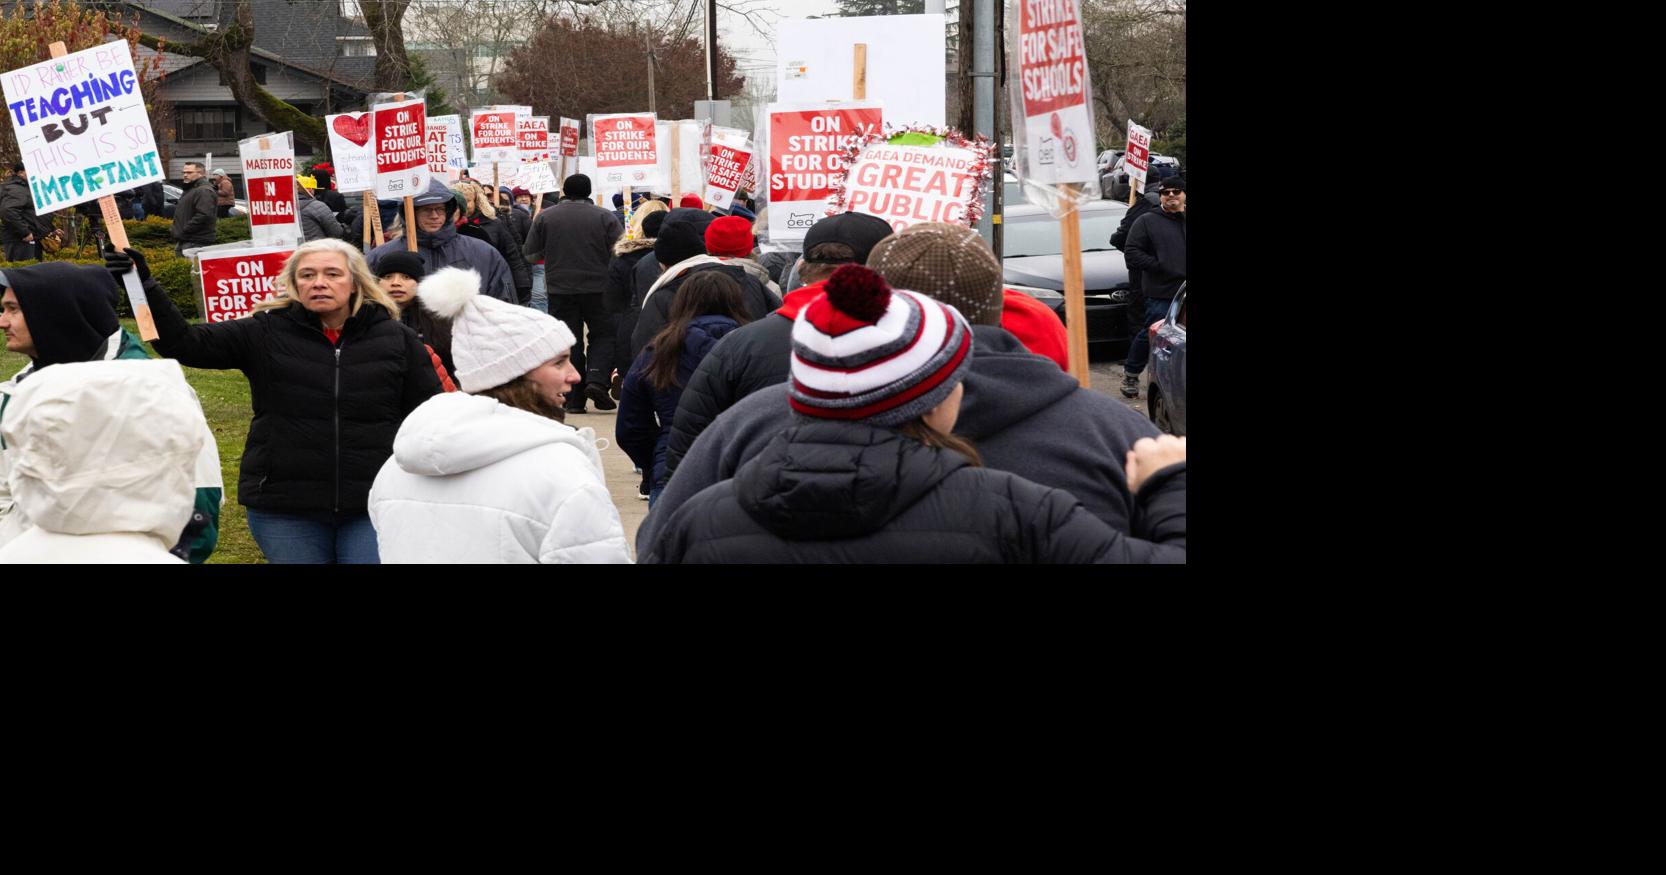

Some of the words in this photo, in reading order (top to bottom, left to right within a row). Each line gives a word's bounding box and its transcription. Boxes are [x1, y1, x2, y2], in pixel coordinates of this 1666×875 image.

[1028, 0, 1074, 28] STRIKE
[1021, 31, 1048, 65] FOR
[1049, 25, 1082, 61] SAFE
[95, 48, 123, 70] BE
[1024, 62, 1082, 100] SCHOOLS
[9, 69, 136, 126] TEACHING
[41, 106, 113, 143] BUT
[396, 110, 410, 123] ON
[616, 120, 633, 130] ON
[811, 115, 840, 132] ON
[385, 122, 418, 138] STRIKE
[480, 122, 509, 130] STRIKE
[381, 138, 405, 152] FOR
[406, 135, 421, 147] OUR
[474, 136, 515, 144] STUDENTS
[604, 130, 645, 141] STRIKE
[788, 135, 853, 152] STRIK
[1130, 130, 1148, 147] GAEA
[27, 142, 78, 174] THIS
[92, 132, 116, 159] IS
[123, 124, 149, 147] SO
[601, 141, 624, 151] FOR
[626, 140, 650, 150] OUR
[1133, 146, 1142, 158] ON
[377, 147, 426, 165] STUDENTS
[597, 150, 656, 161] STUDENTS
[710, 154, 740, 171] STRIKE
[720, 149, 735, 160] ON
[781, 154, 822, 171] FOR
[865, 150, 899, 161] GAEA
[1127, 151, 1148, 169] STRIKE
[246, 158, 293, 170] MAESTROS
[717, 166, 742, 181] SAFE
[771, 173, 843, 190] STUDE
[857, 162, 969, 198] GREAT
[251, 201, 294, 216] HUELGA
[847, 190, 962, 225] PUBLIC
[787, 217, 813, 226] oea
[236, 260, 265, 277] ON
[216, 276, 282, 294] STRIK
[208, 295, 248, 311] FOR
